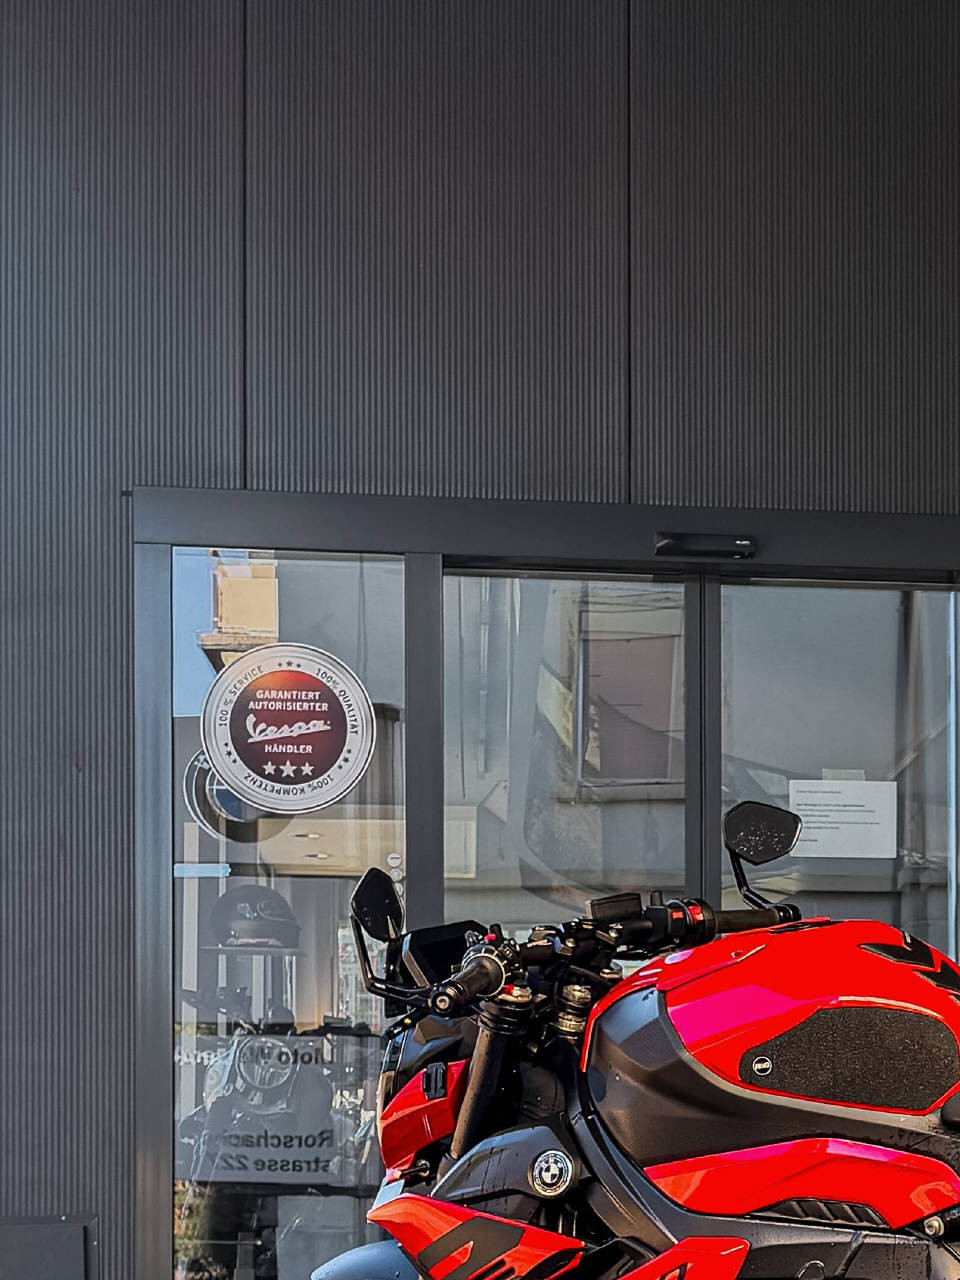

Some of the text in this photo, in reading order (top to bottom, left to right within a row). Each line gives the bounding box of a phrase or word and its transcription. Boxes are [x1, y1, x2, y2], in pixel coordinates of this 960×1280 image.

[229, 665, 264, 696] SERVICE
[248, 701, 329, 711] AUTORISIERTER
[256, 690, 321, 700] GARANTIERT
[315, 668, 358, 735] 100% QUALITÄT
[245, 713, 332, 743] Vespa
[264, 743, 313, 754] HÄNDLER
[243, 773, 334, 796] 100% KOMPETENZ
